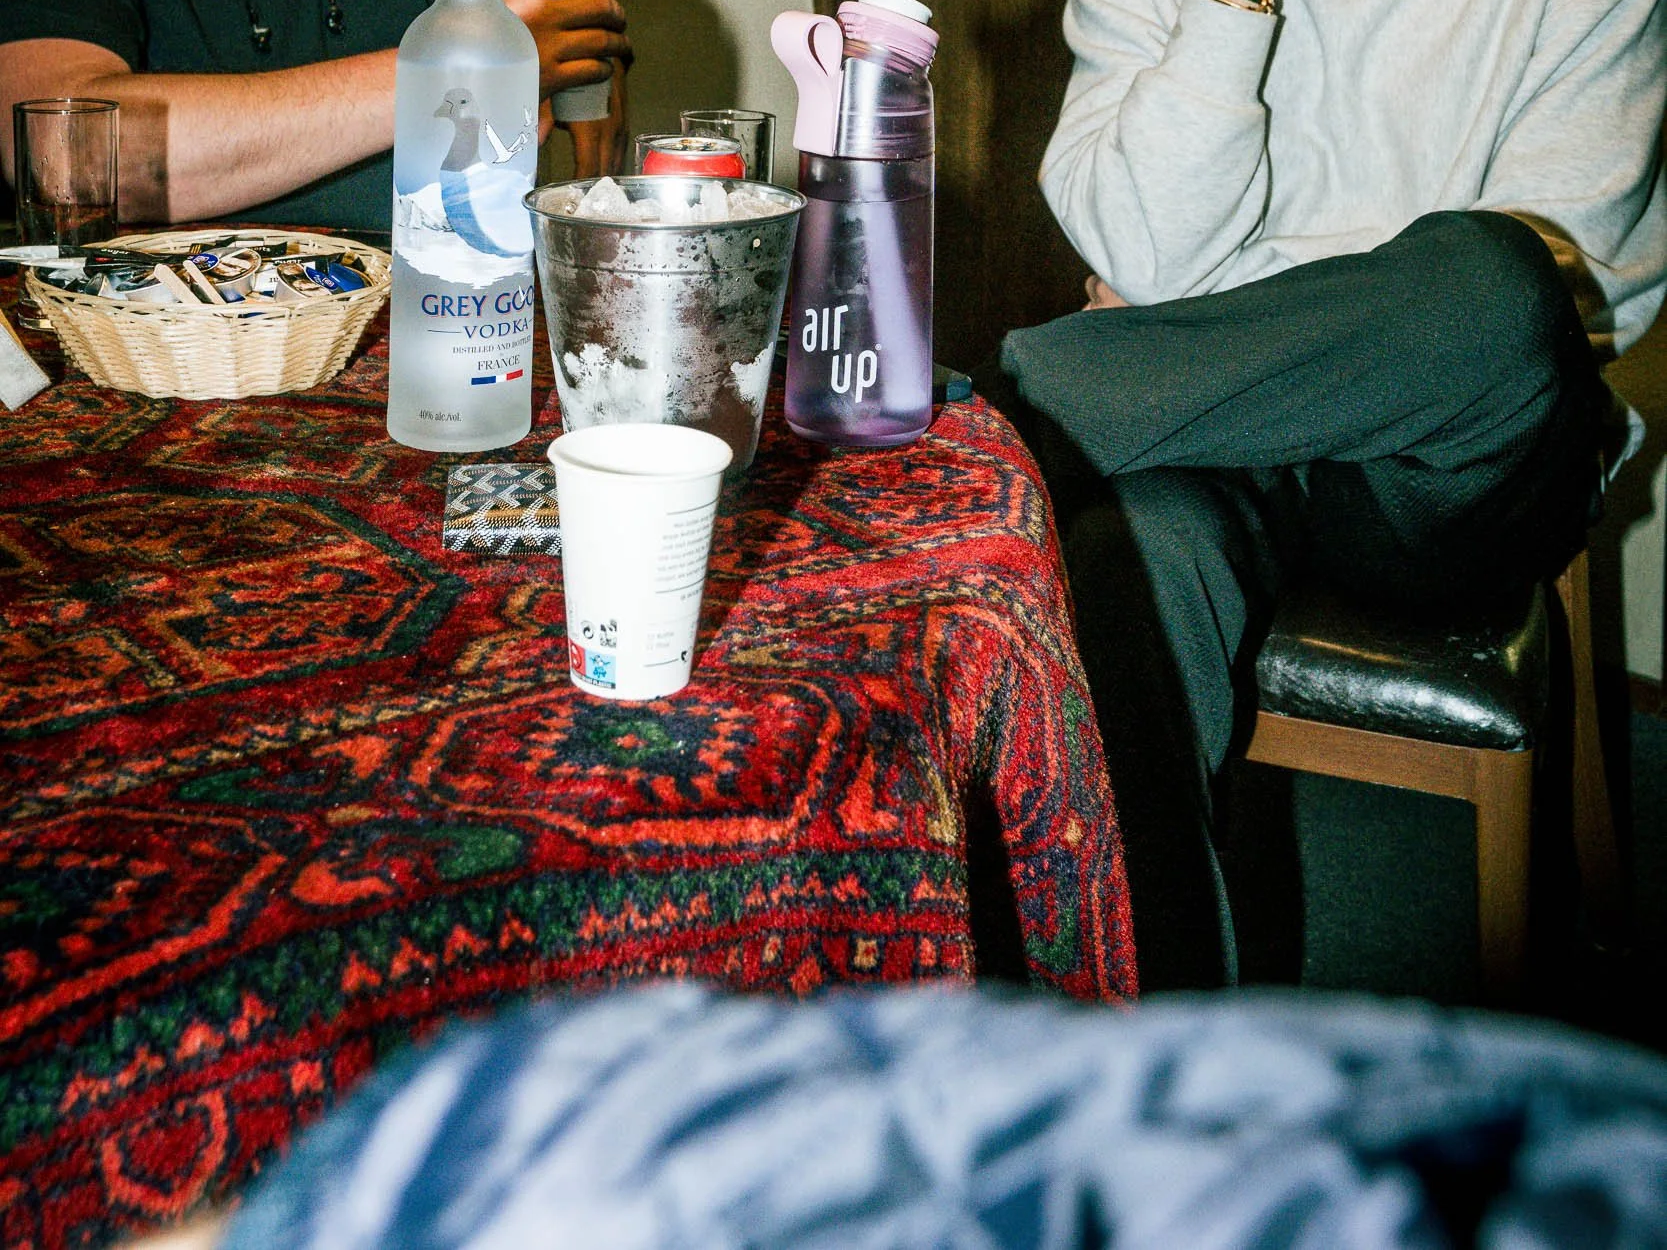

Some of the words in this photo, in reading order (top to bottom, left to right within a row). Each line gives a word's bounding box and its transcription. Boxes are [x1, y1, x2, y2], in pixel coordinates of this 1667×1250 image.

[421, 293, 487, 318] GREY
[494, 285, 534, 314] GOO
[463, 318, 528, 339] VODKA
[802, 304, 849, 353] air
[452, 346, 494, 354] DISTILLED
[496, 343, 511, 351] AND
[477, 354, 520, 371] FRANCE
[830, 349, 878, 404] up
[419, 409, 434, 420] 40%
